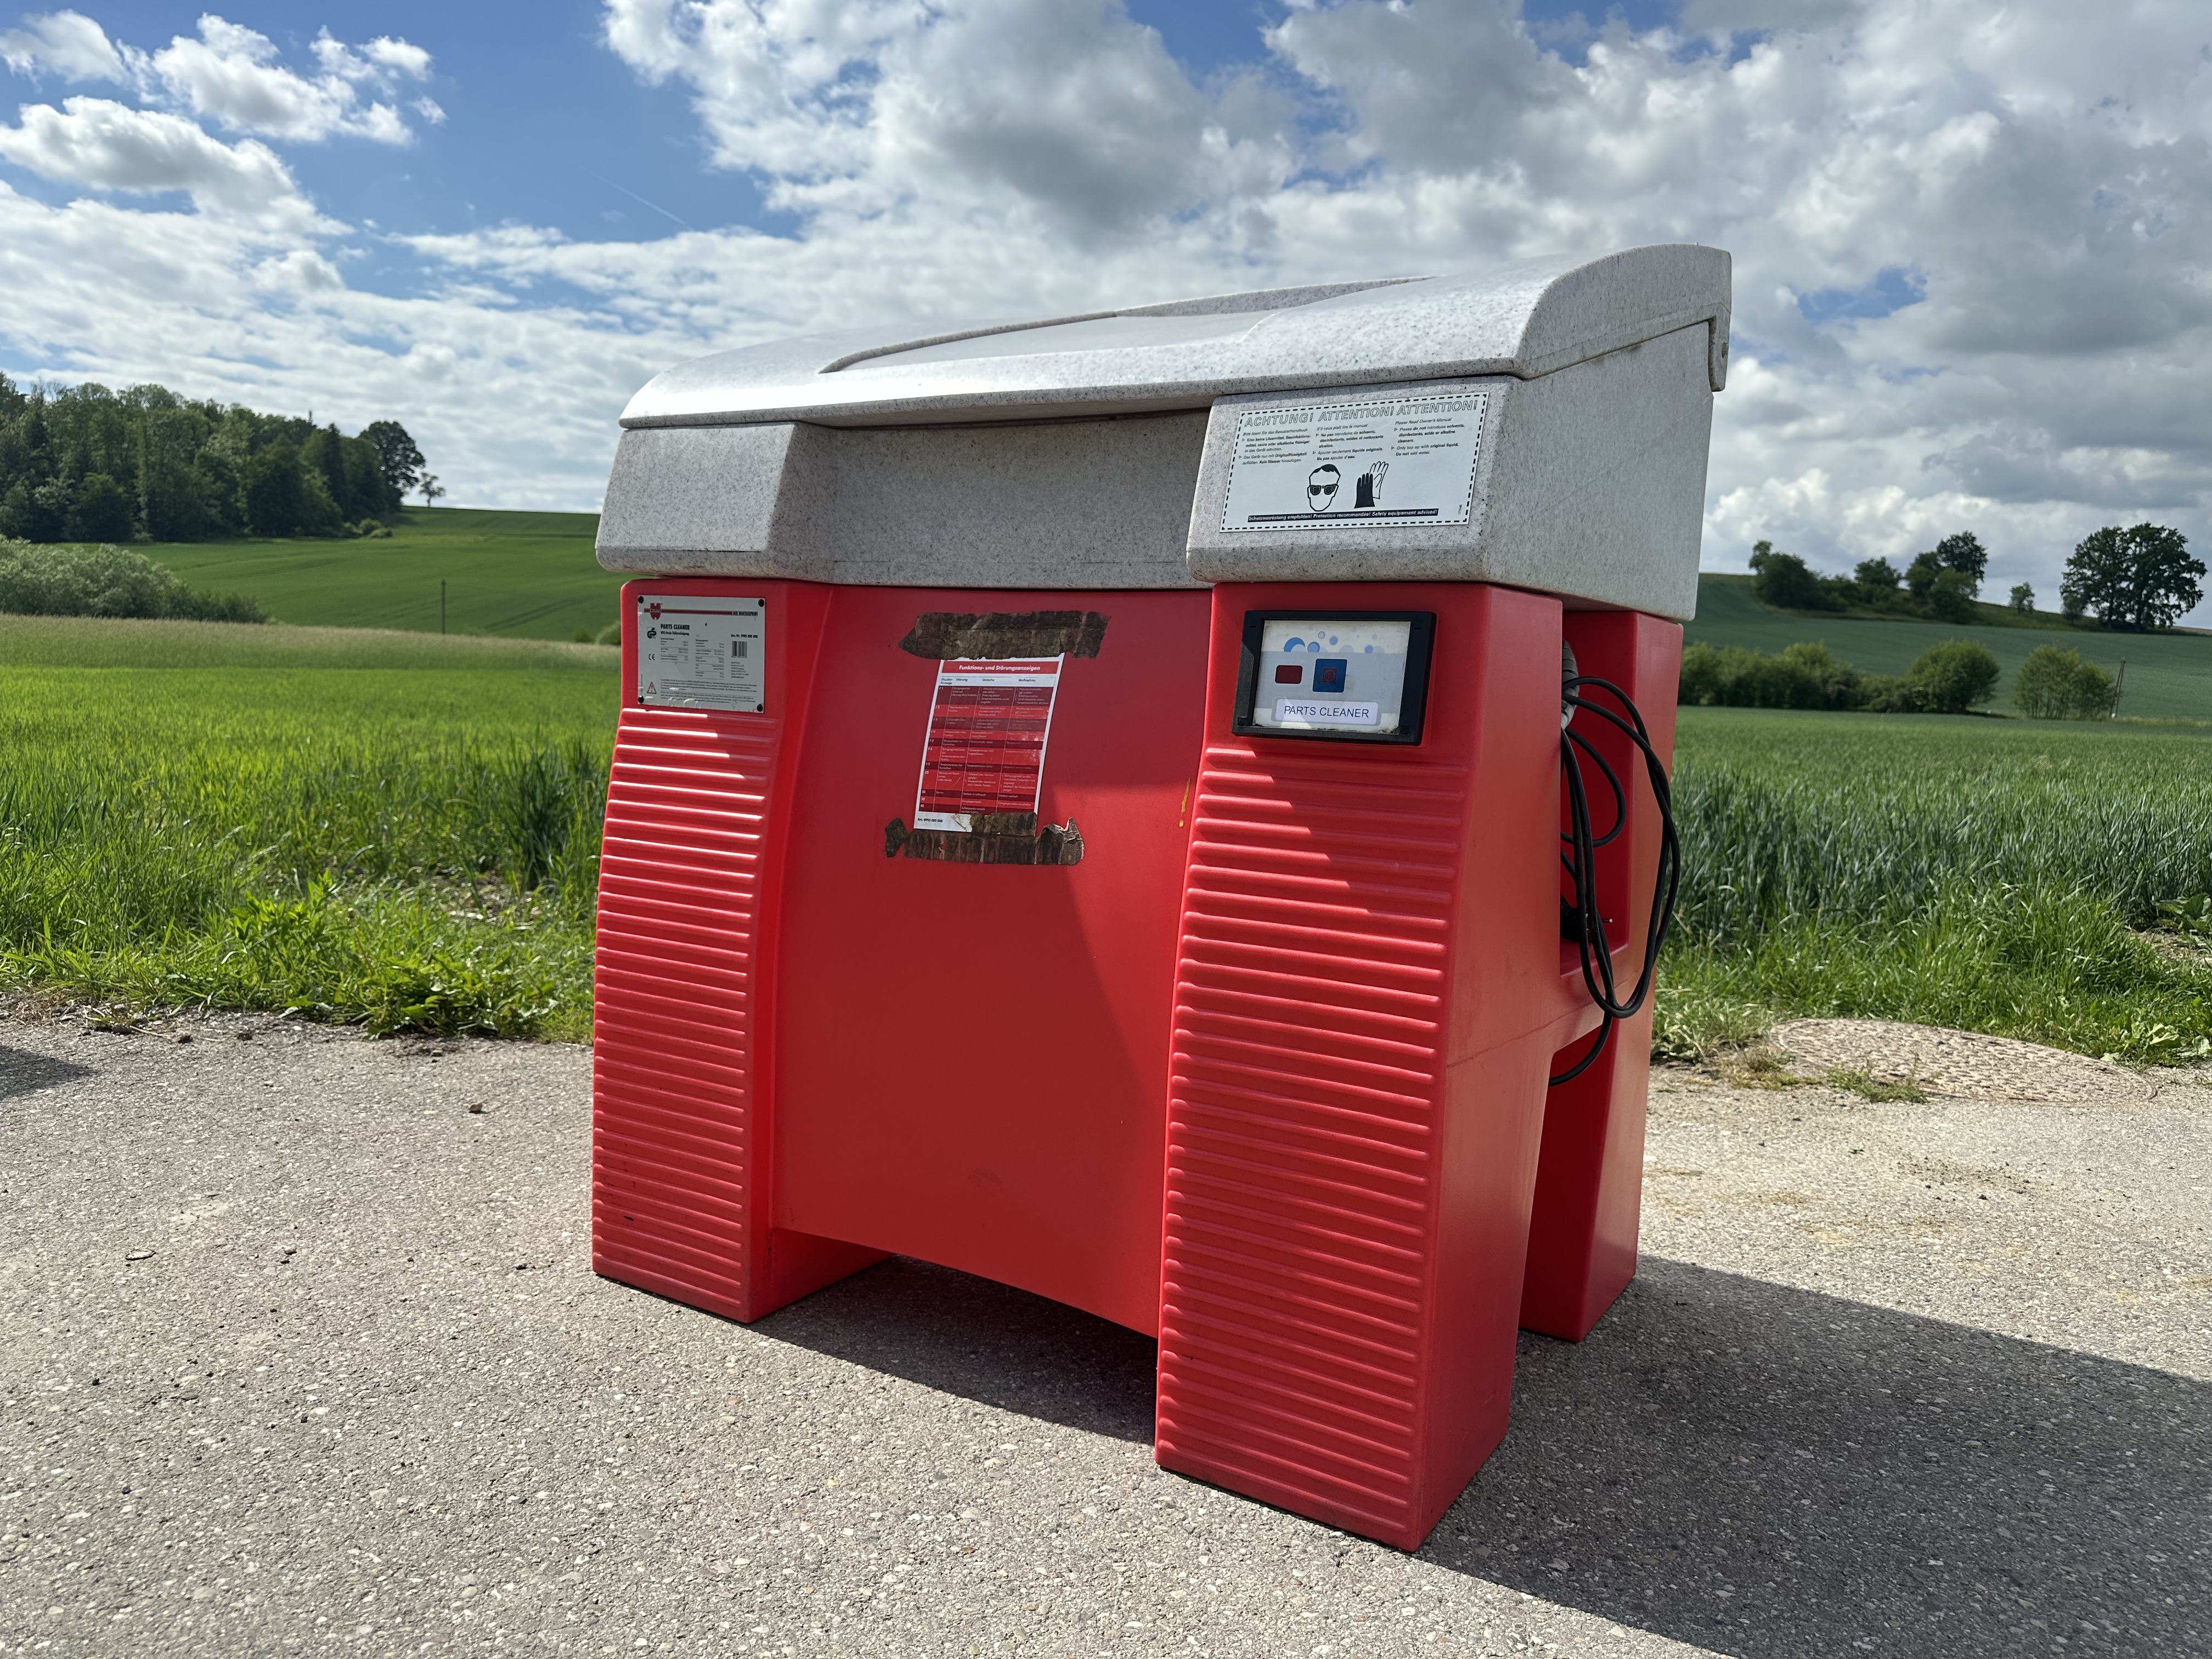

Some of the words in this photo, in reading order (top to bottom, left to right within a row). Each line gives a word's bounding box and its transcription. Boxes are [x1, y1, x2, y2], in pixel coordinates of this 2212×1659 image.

[1244, 413, 1313, 427] ACHTUNG!
[1318, 406, 1394, 421] ATTENTION!
[1396, 400, 1477, 415] ATTENTION!
[1284, 706, 1316, 715] PARTS
[1319, 707, 1369, 718] CLEANER
